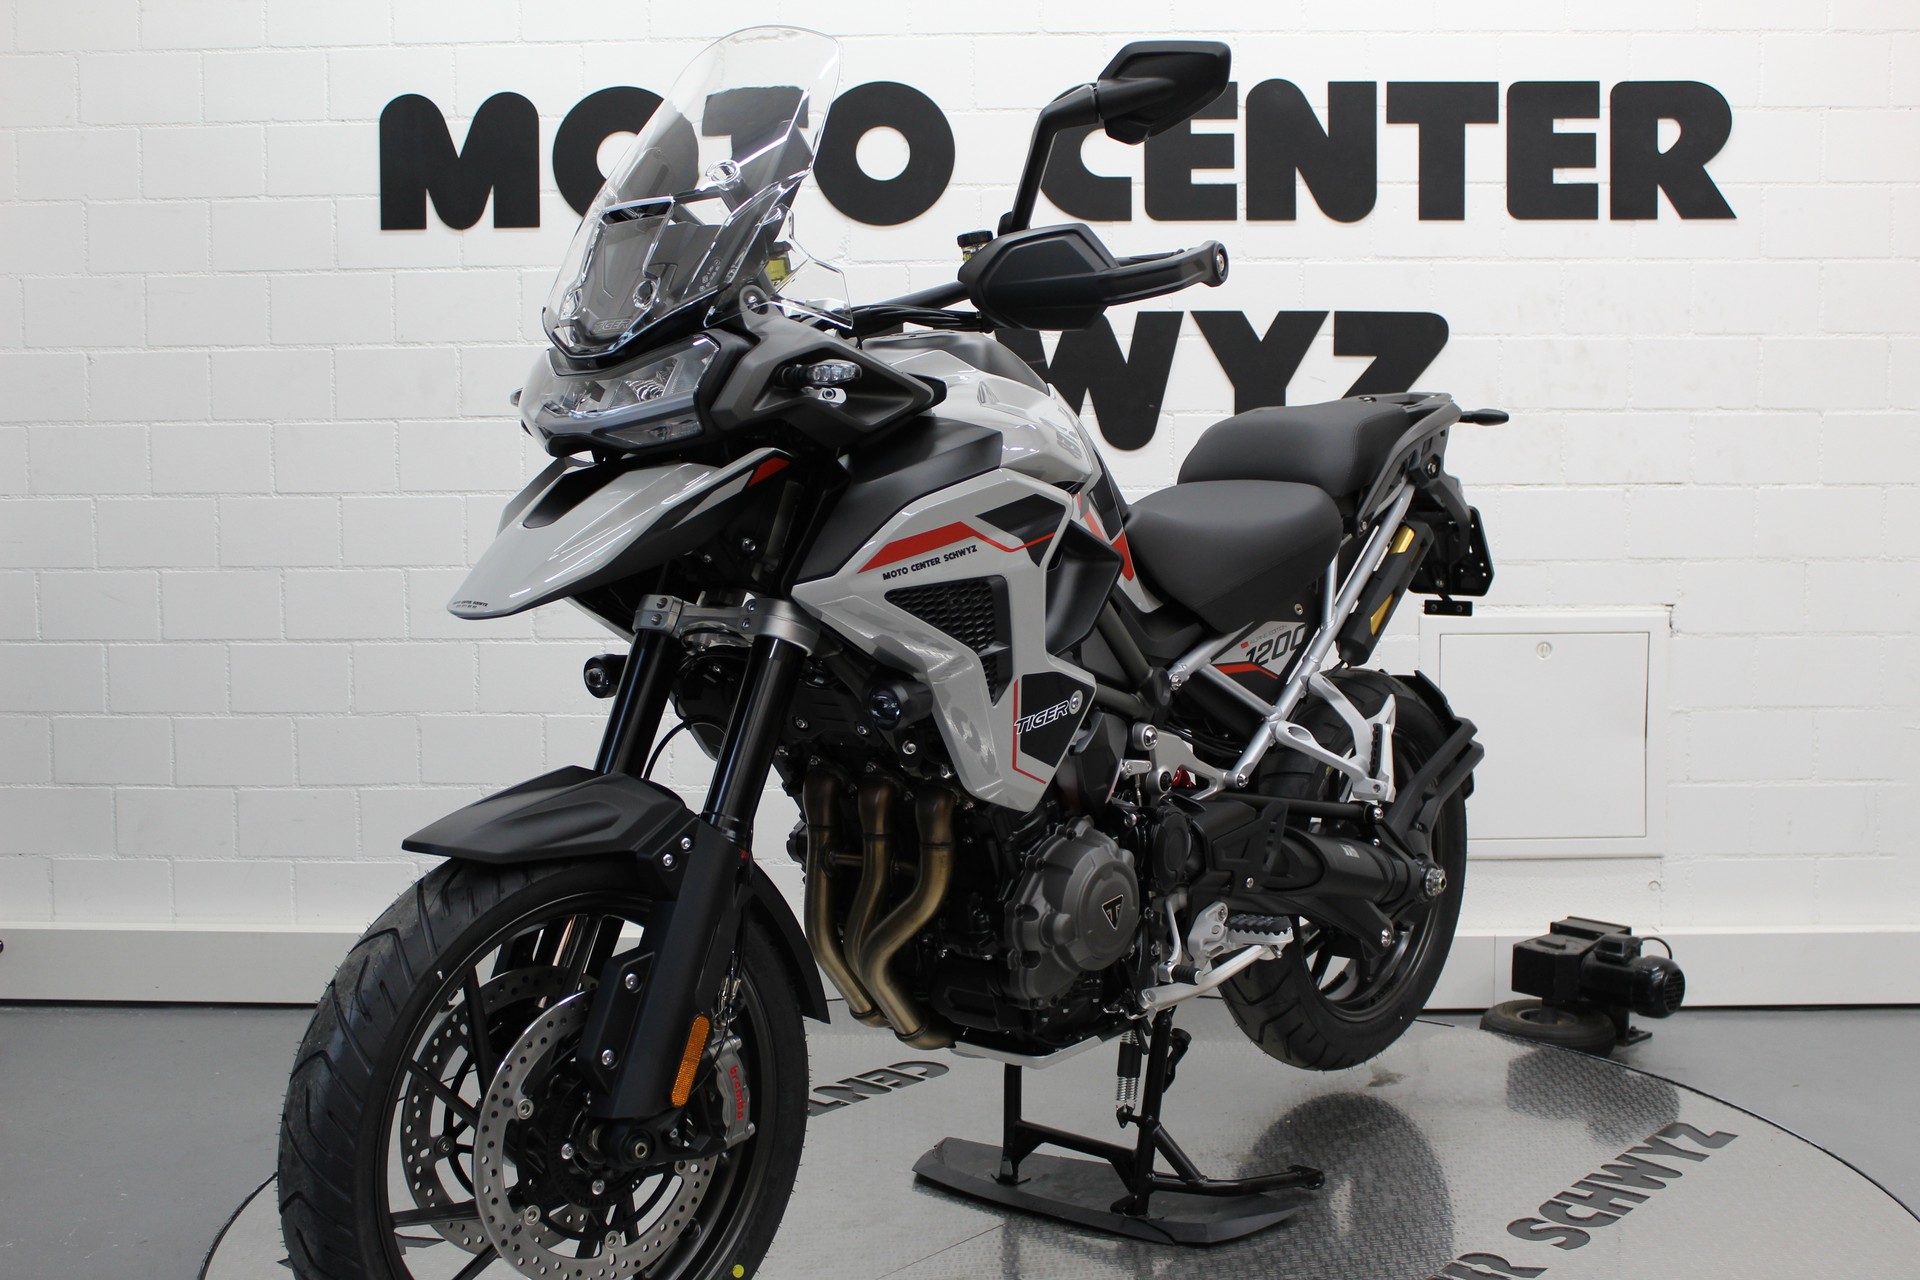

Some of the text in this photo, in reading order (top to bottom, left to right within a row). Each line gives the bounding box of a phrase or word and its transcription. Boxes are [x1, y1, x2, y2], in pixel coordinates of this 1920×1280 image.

[380, 78, 1737, 231] MOTO CENTER
[994, 310, 1449, 451] WYZ
[882, 545, 977, 580] MOTO CENTER SCHWYZ
[1246, 624, 1305, 665] 1200
[1014, 700, 1069, 735] TIGER
[729, 1065, 746, 1120] brembo
[1506, 1122, 1739, 1251] SCHWYZ
